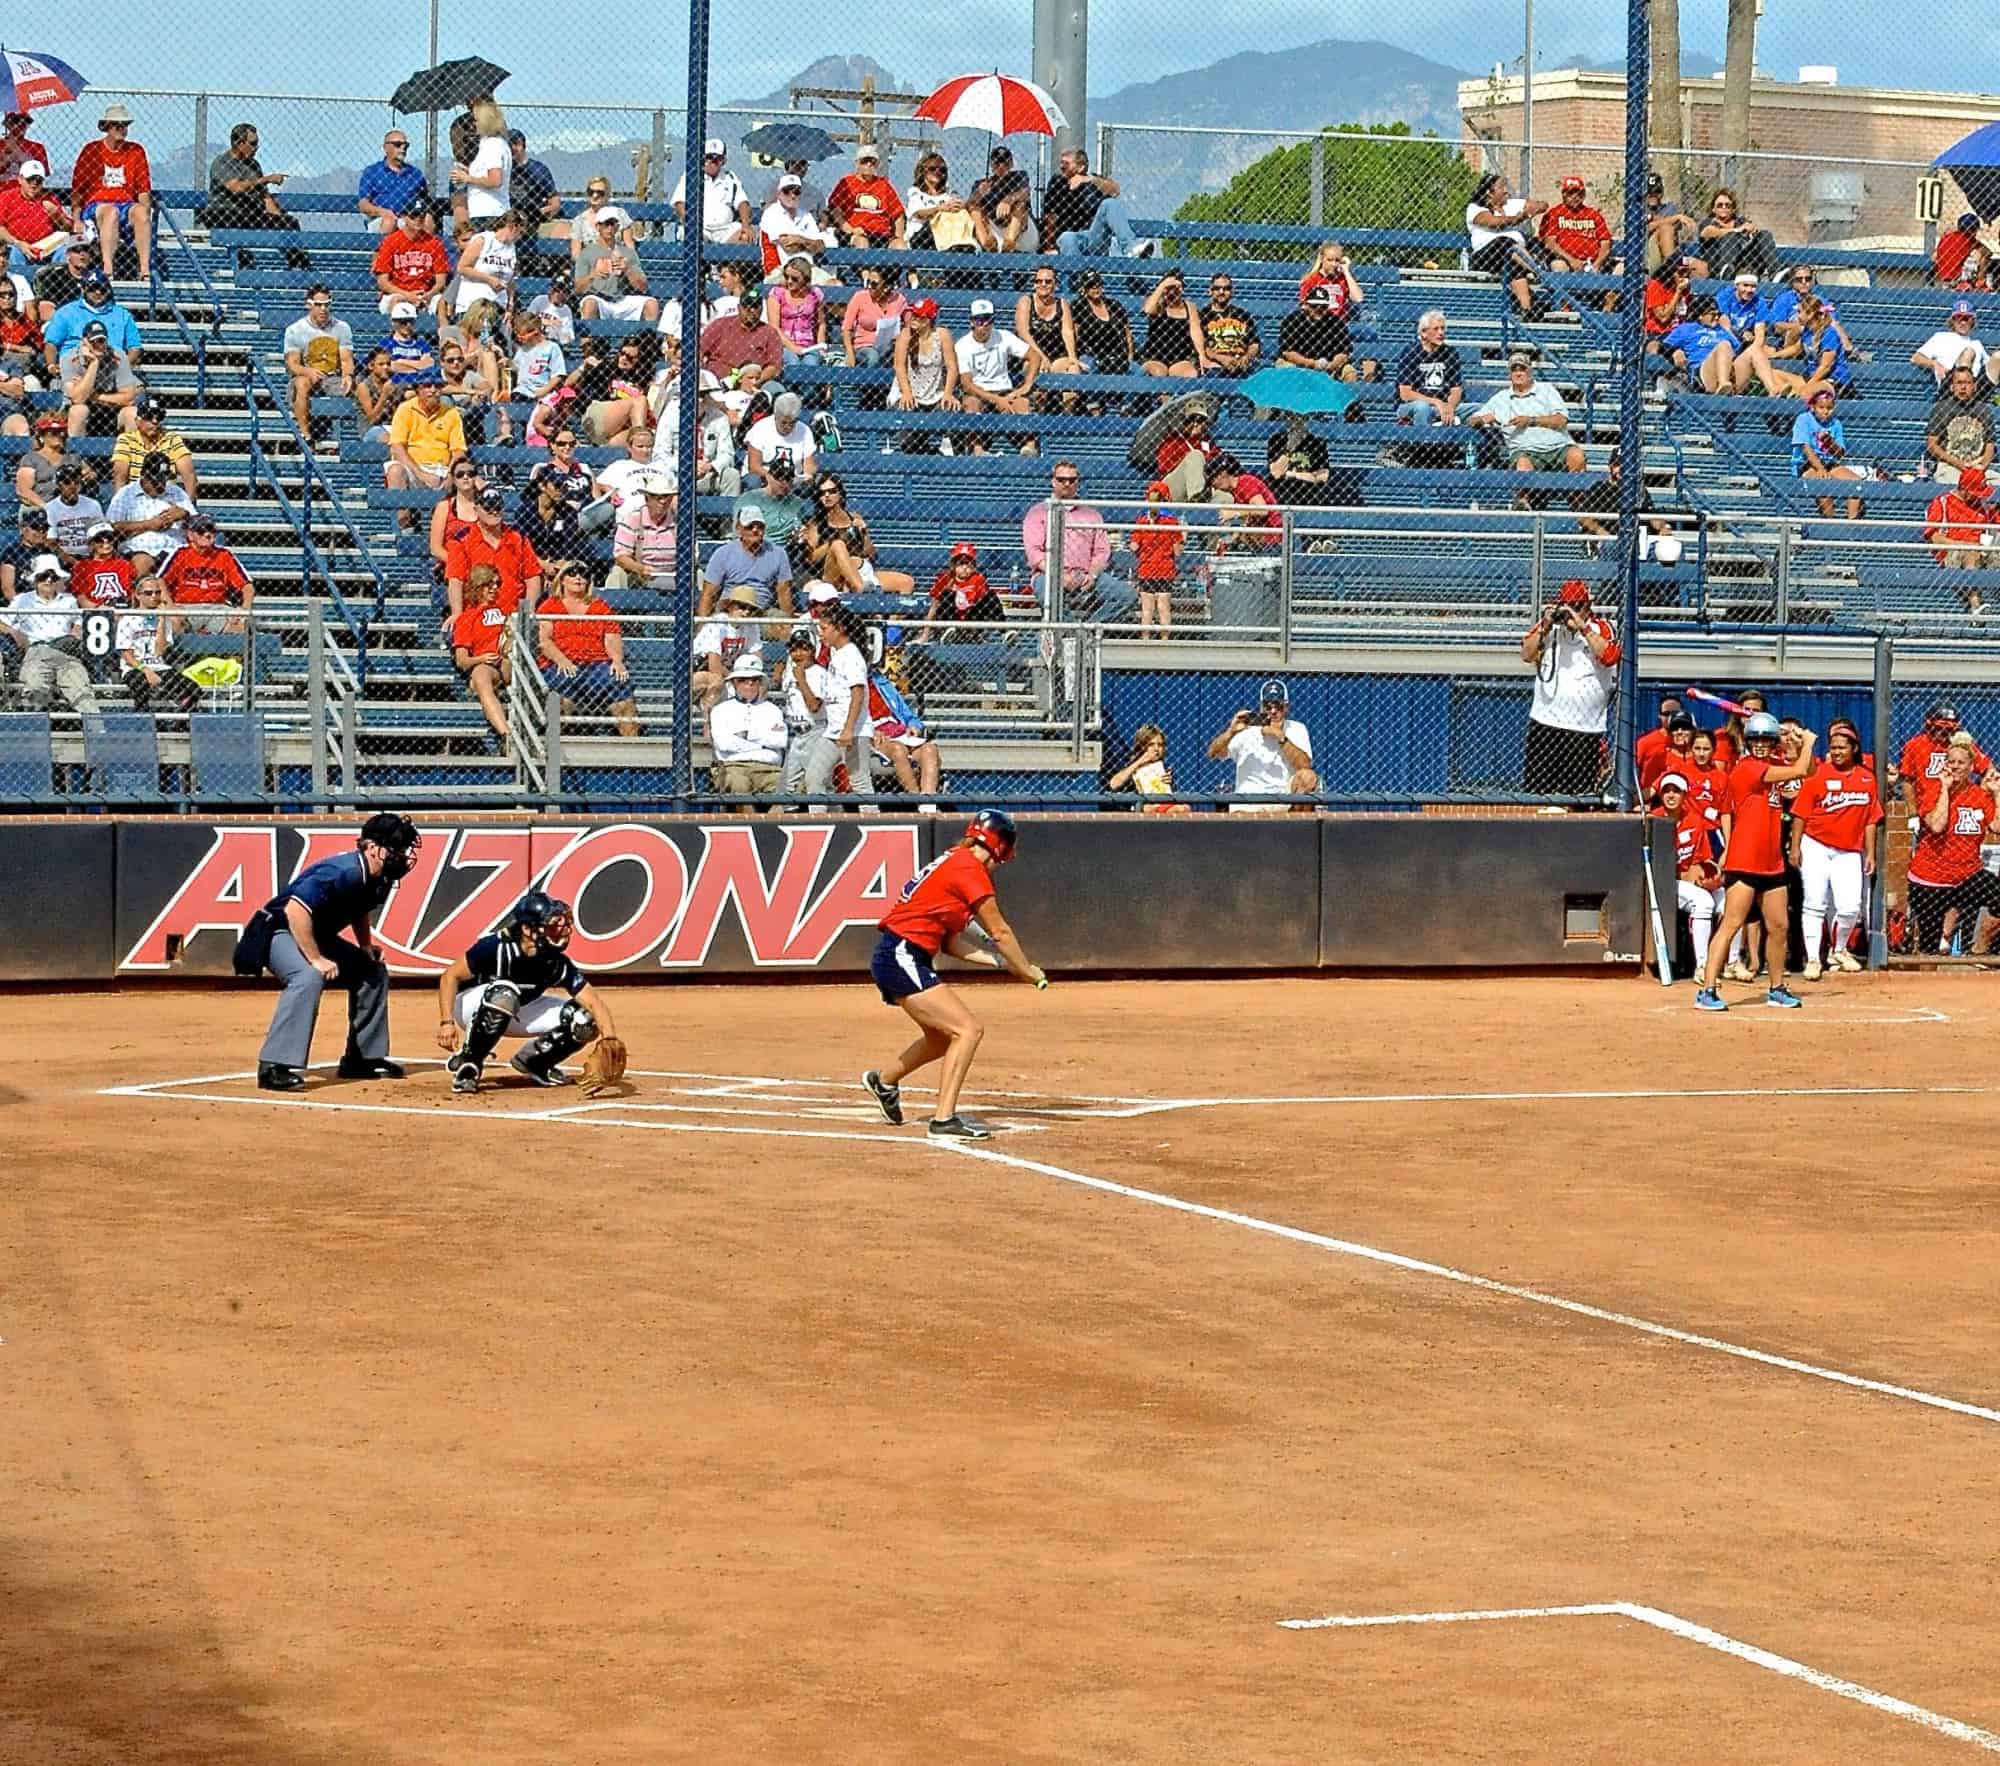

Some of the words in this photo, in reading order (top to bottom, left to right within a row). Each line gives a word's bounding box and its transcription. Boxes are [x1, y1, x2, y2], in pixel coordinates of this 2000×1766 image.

[1918, 180, 1942, 220] 10
[90, 571, 128, 599] A
[86, 615, 110, 655] 8
[1954, 806, 1982, 835] A
